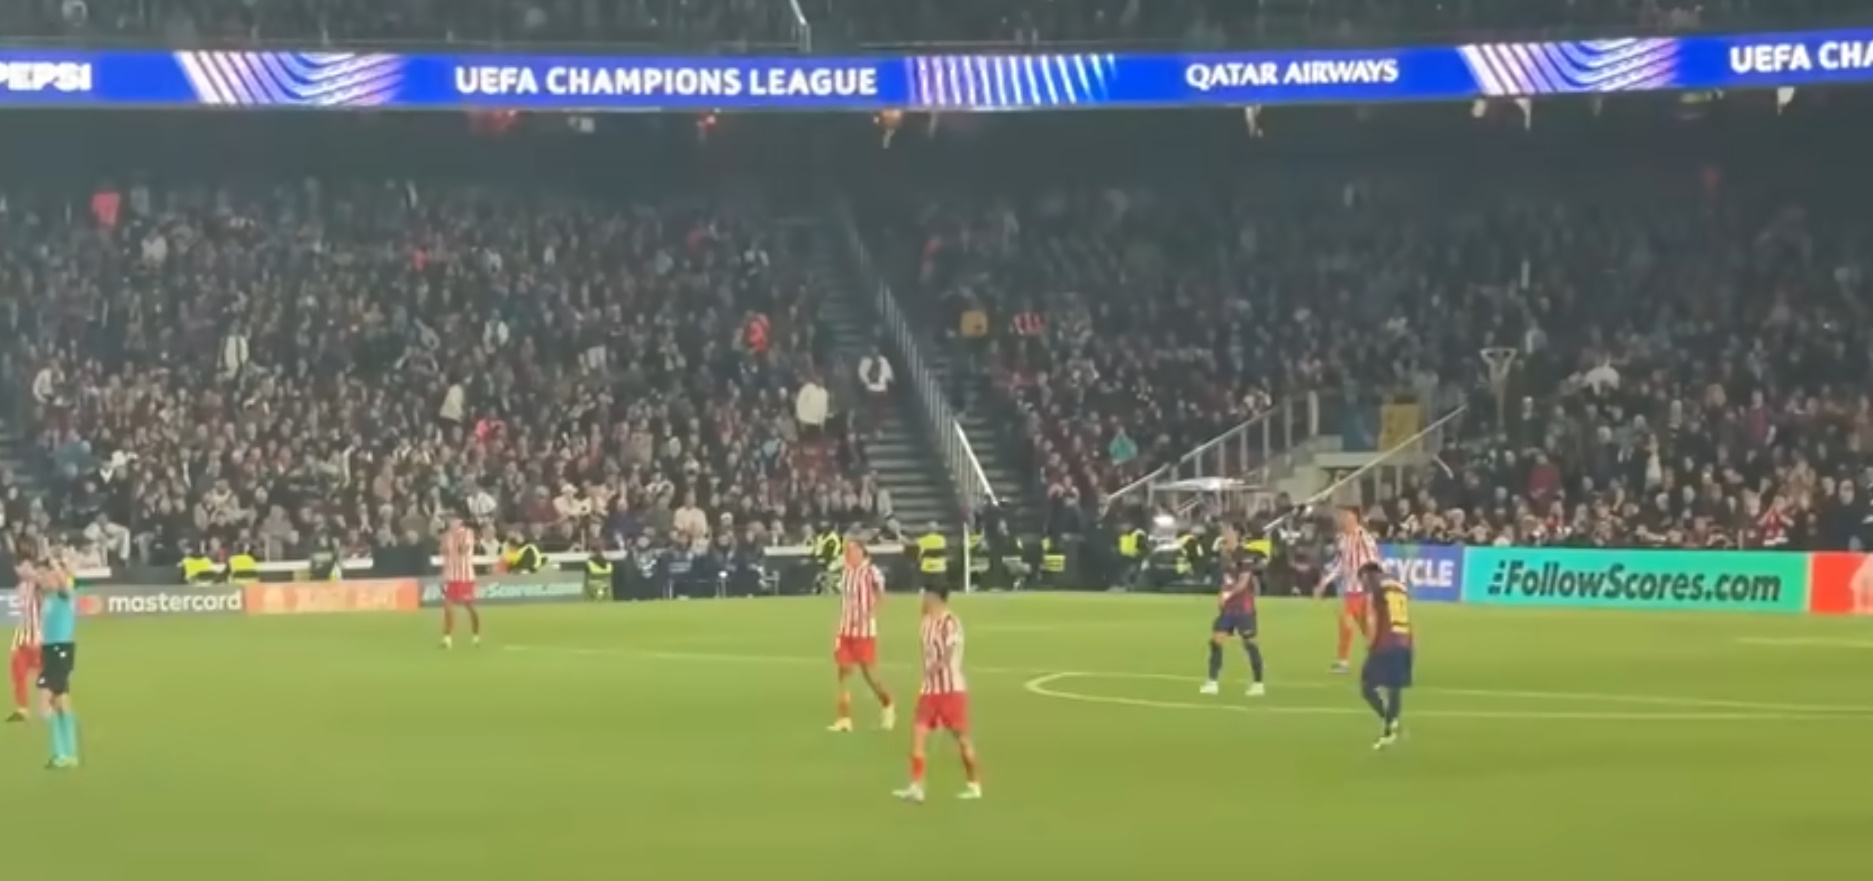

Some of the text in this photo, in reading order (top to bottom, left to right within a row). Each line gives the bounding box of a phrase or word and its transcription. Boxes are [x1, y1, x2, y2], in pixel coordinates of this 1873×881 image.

[1729, 43, 1813, 74] UEFA
[454, 65, 878, 96] UEFA CHAMPIONS LEAGUE
[1186, 58, 1399, 91] QATAR AIRWAYS
[1504, 559, 1781, 602] FollowScores.com
[108, 589, 243, 612] mastercard
